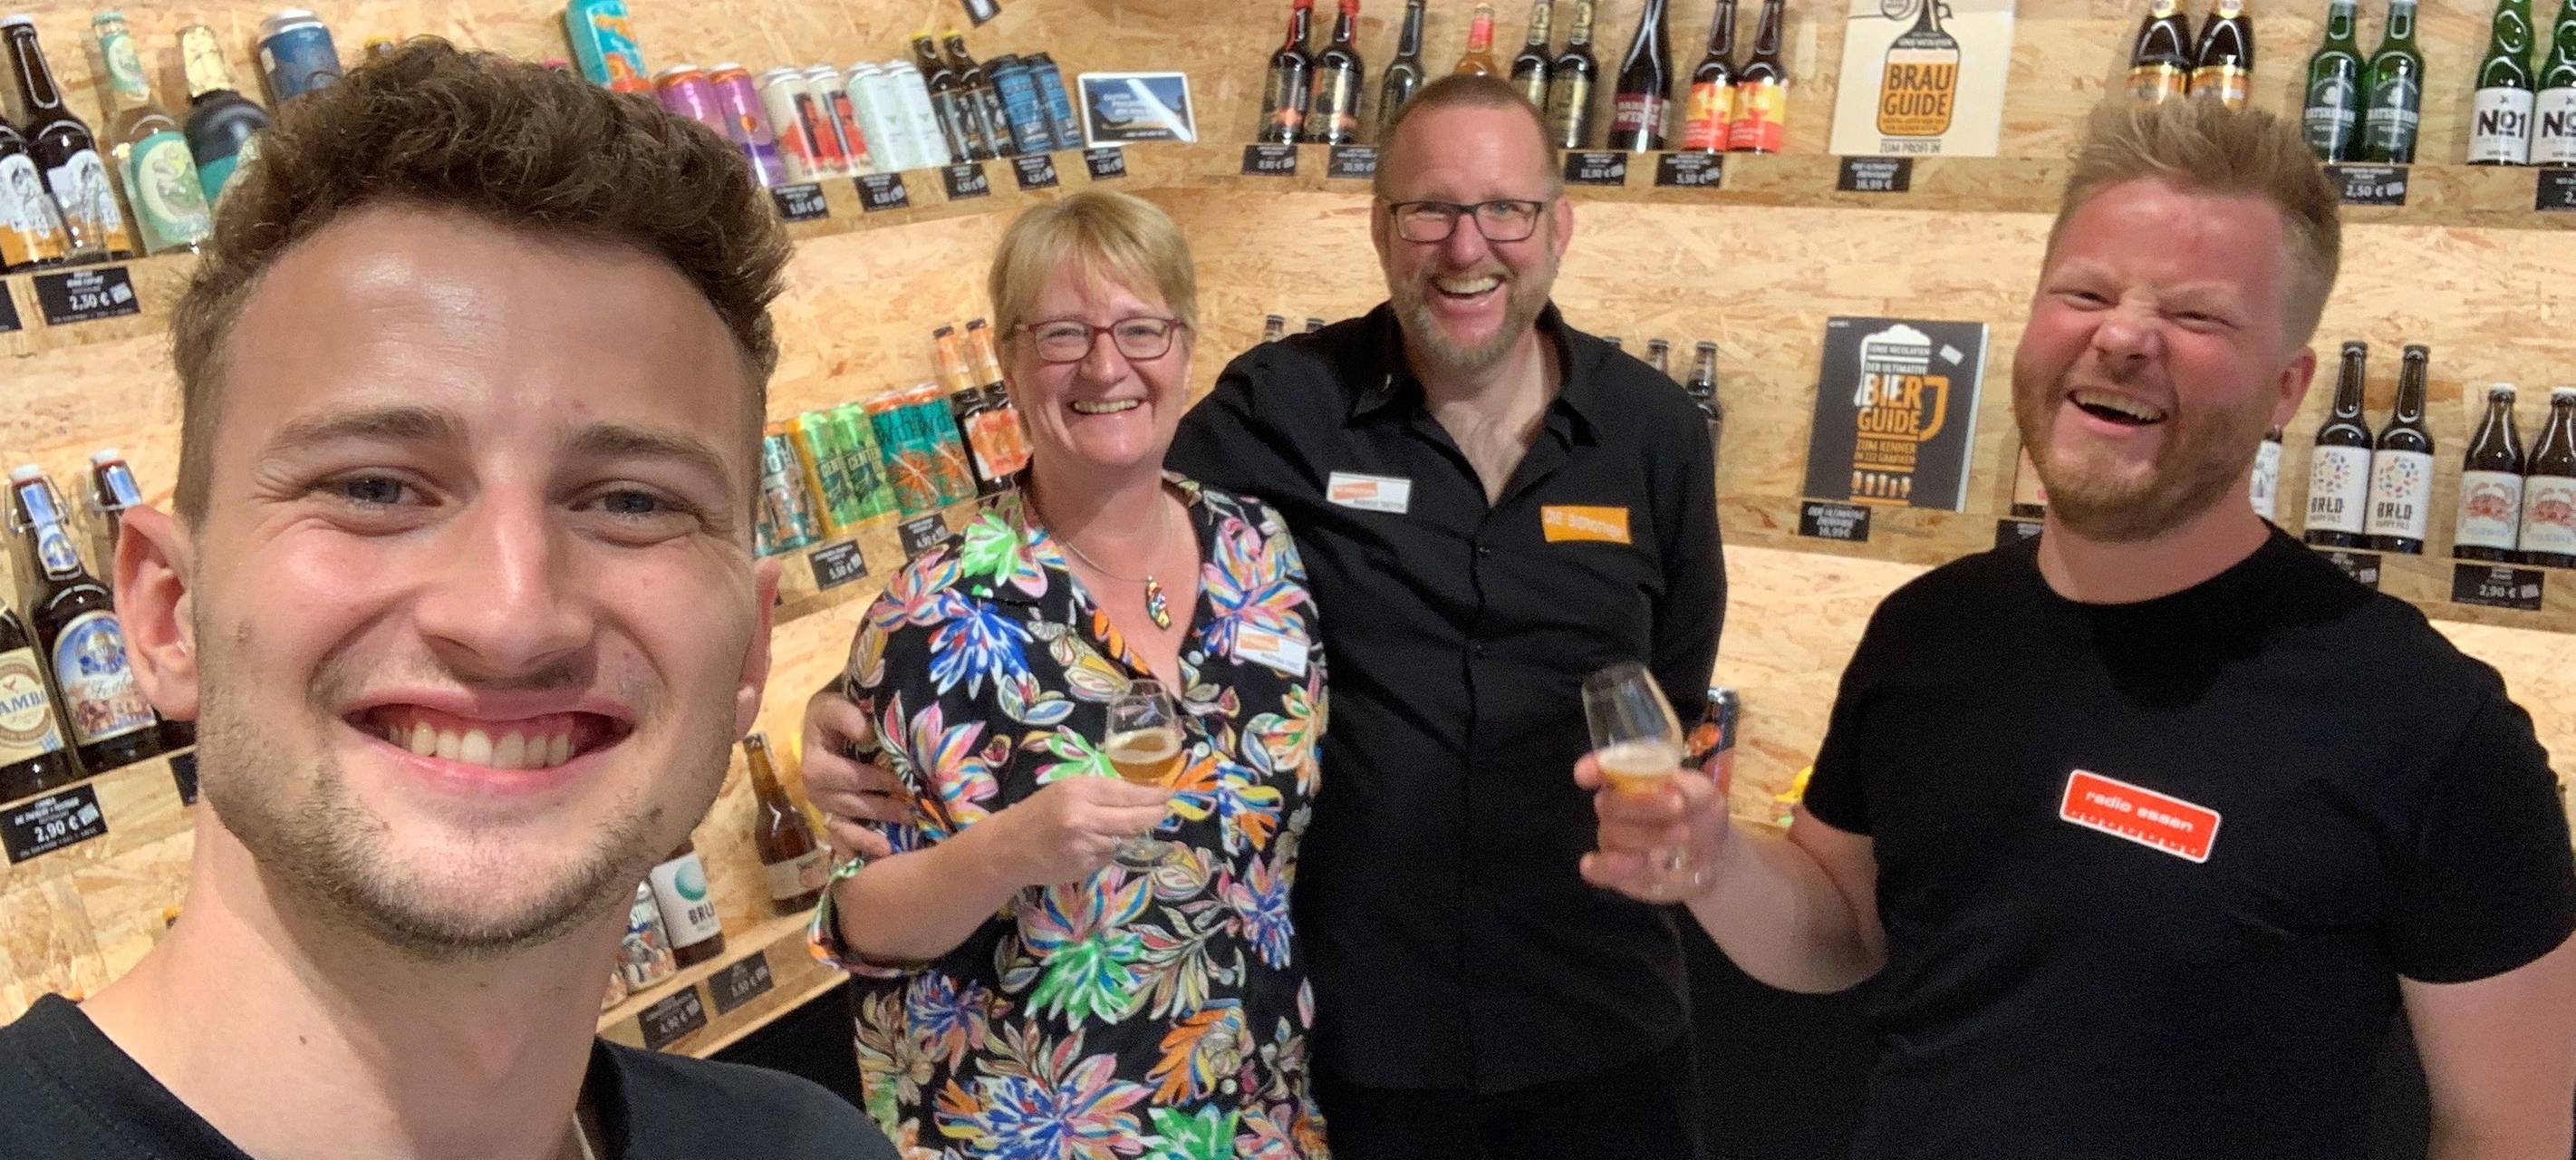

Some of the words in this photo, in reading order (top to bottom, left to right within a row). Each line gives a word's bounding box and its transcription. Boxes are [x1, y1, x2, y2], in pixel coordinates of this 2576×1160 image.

[1888, 64, 1953, 91] BRAU
[1884, 93, 1948, 116] GUIDE
[1879, 143, 1900, 153] ZUM
[2375, 185, 2385, 197] €
[100, 291, 110, 306] €
[1862, 372, 1922, 410] BIER
[1857, 407, 1921, 434] GUIDE
[2508, 587, 2517, 599] €
[2086, 790, 2132, 813] radio
[2137, 807, 2194, 833] essen
[69, 815, 80, 831] €
